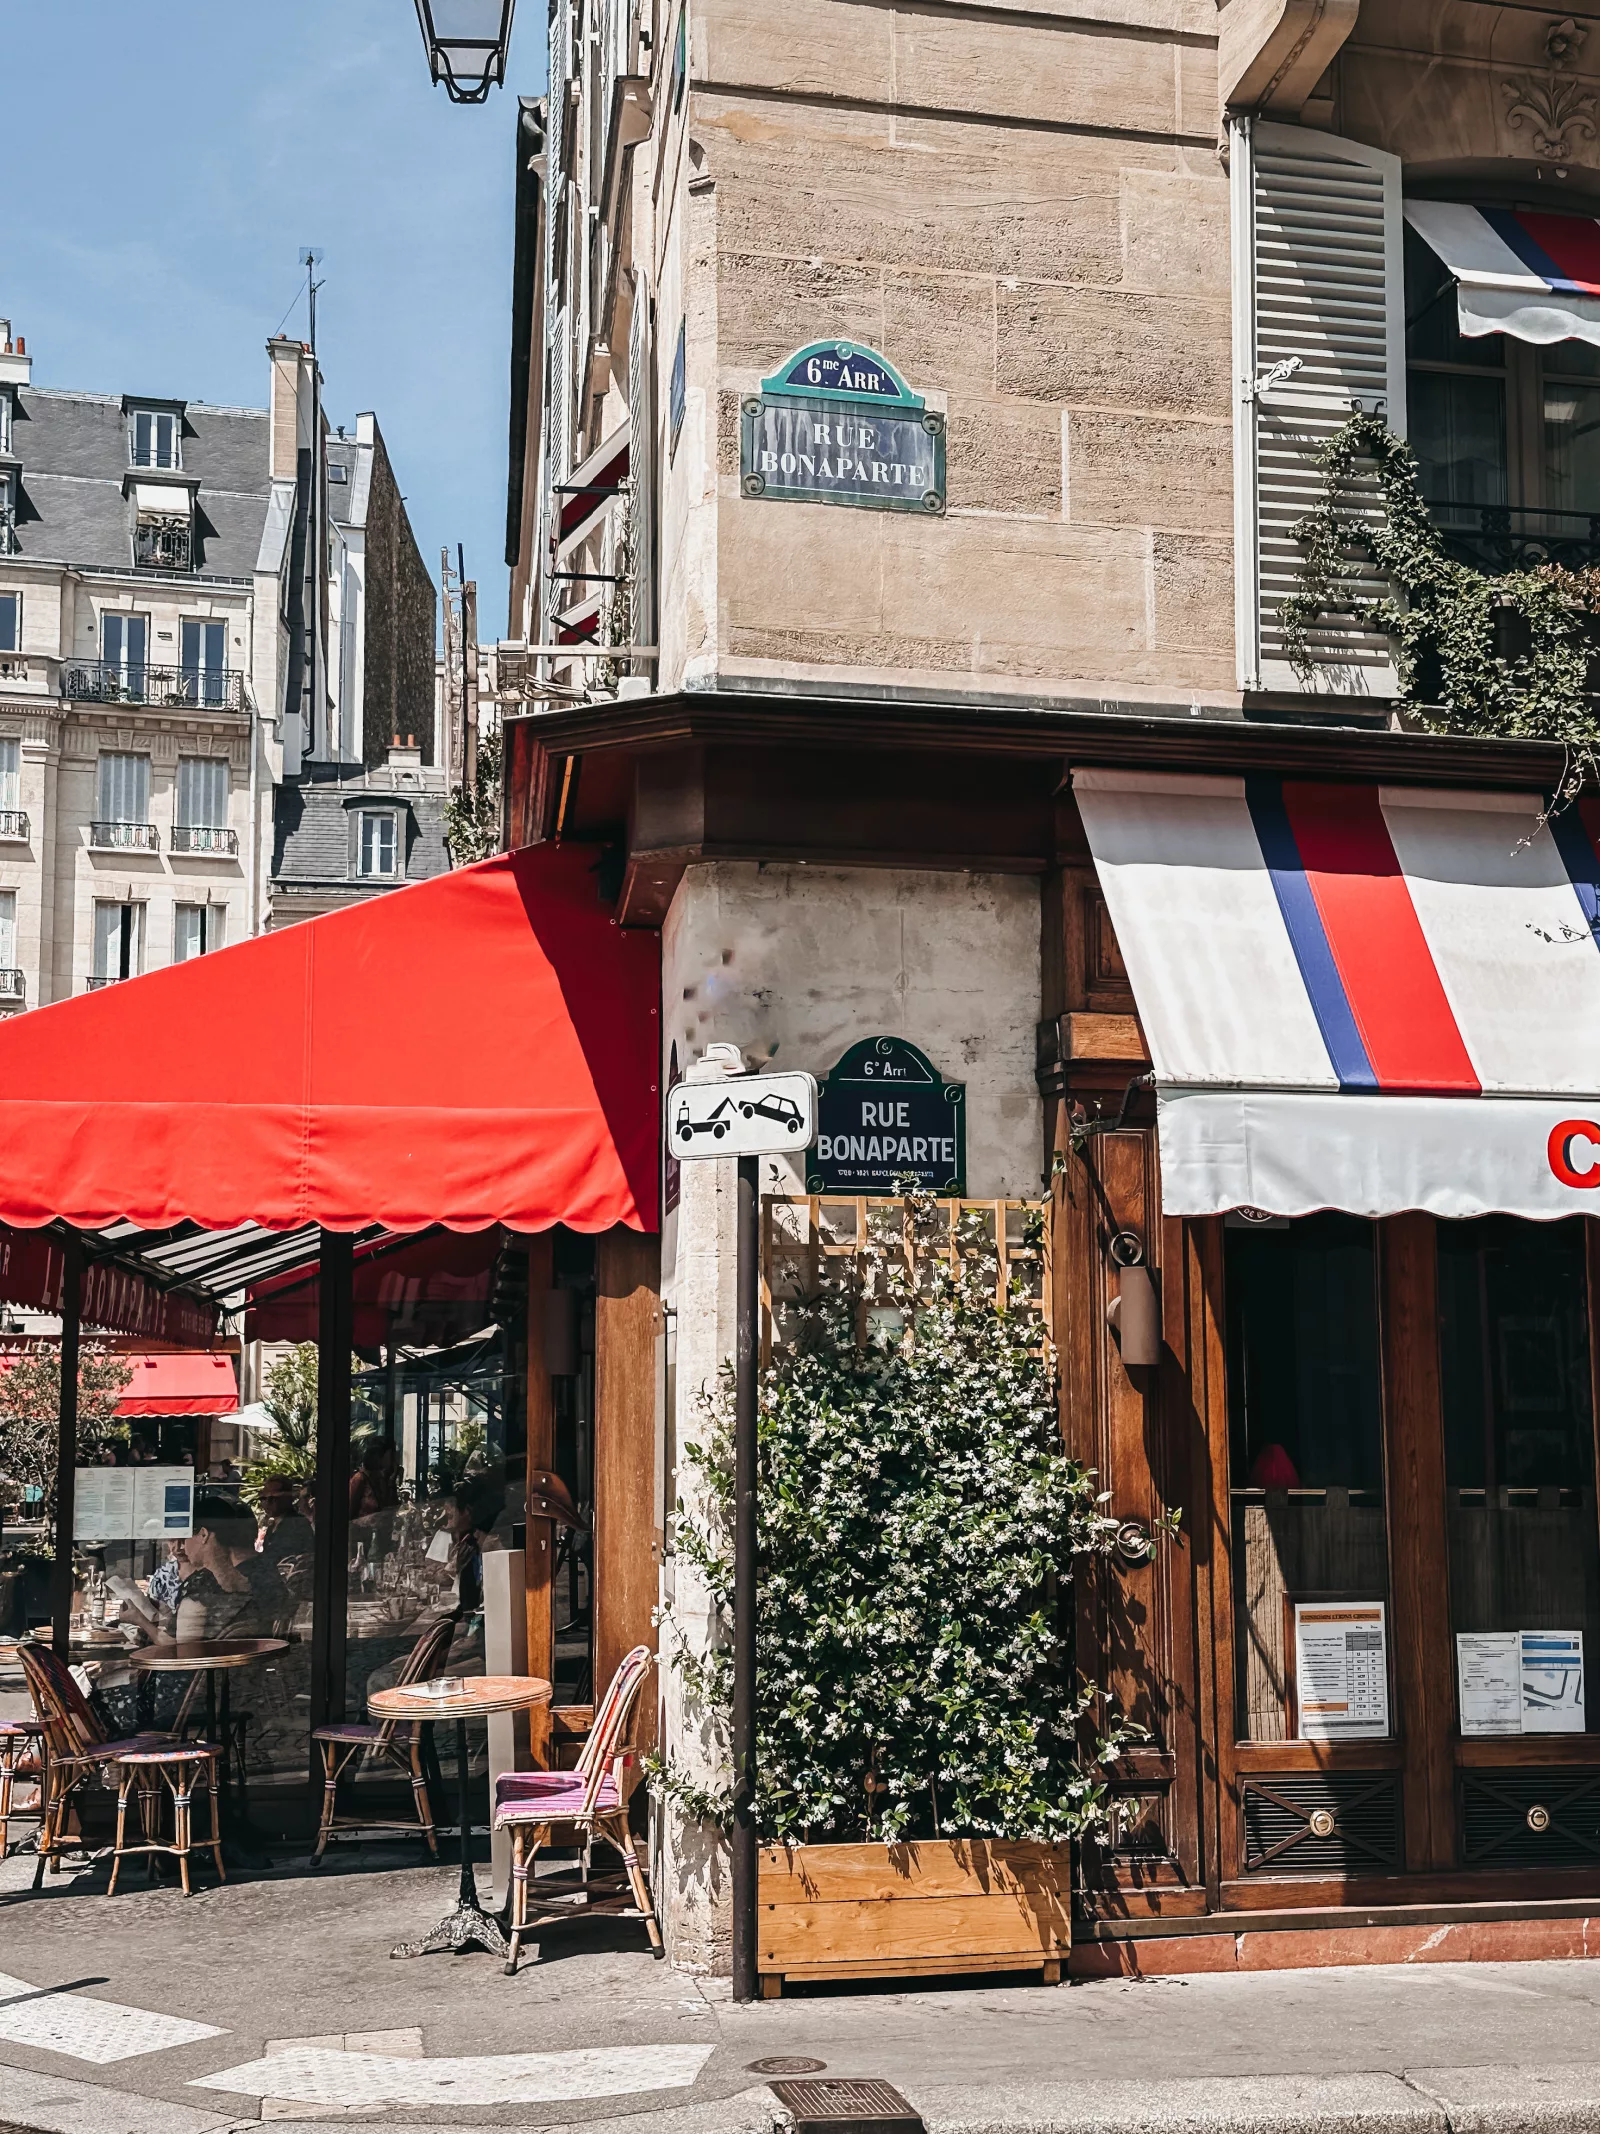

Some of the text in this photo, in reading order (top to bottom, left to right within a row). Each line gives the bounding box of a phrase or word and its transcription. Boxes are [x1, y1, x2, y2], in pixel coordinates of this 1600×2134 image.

[813, 423, 875, 450] RUE
[760, 450, 925, 487] BONAPARTE
[861, 1101, 910, 1128] RUE
[817, 1134, 955, 1163] BONAPARTE
